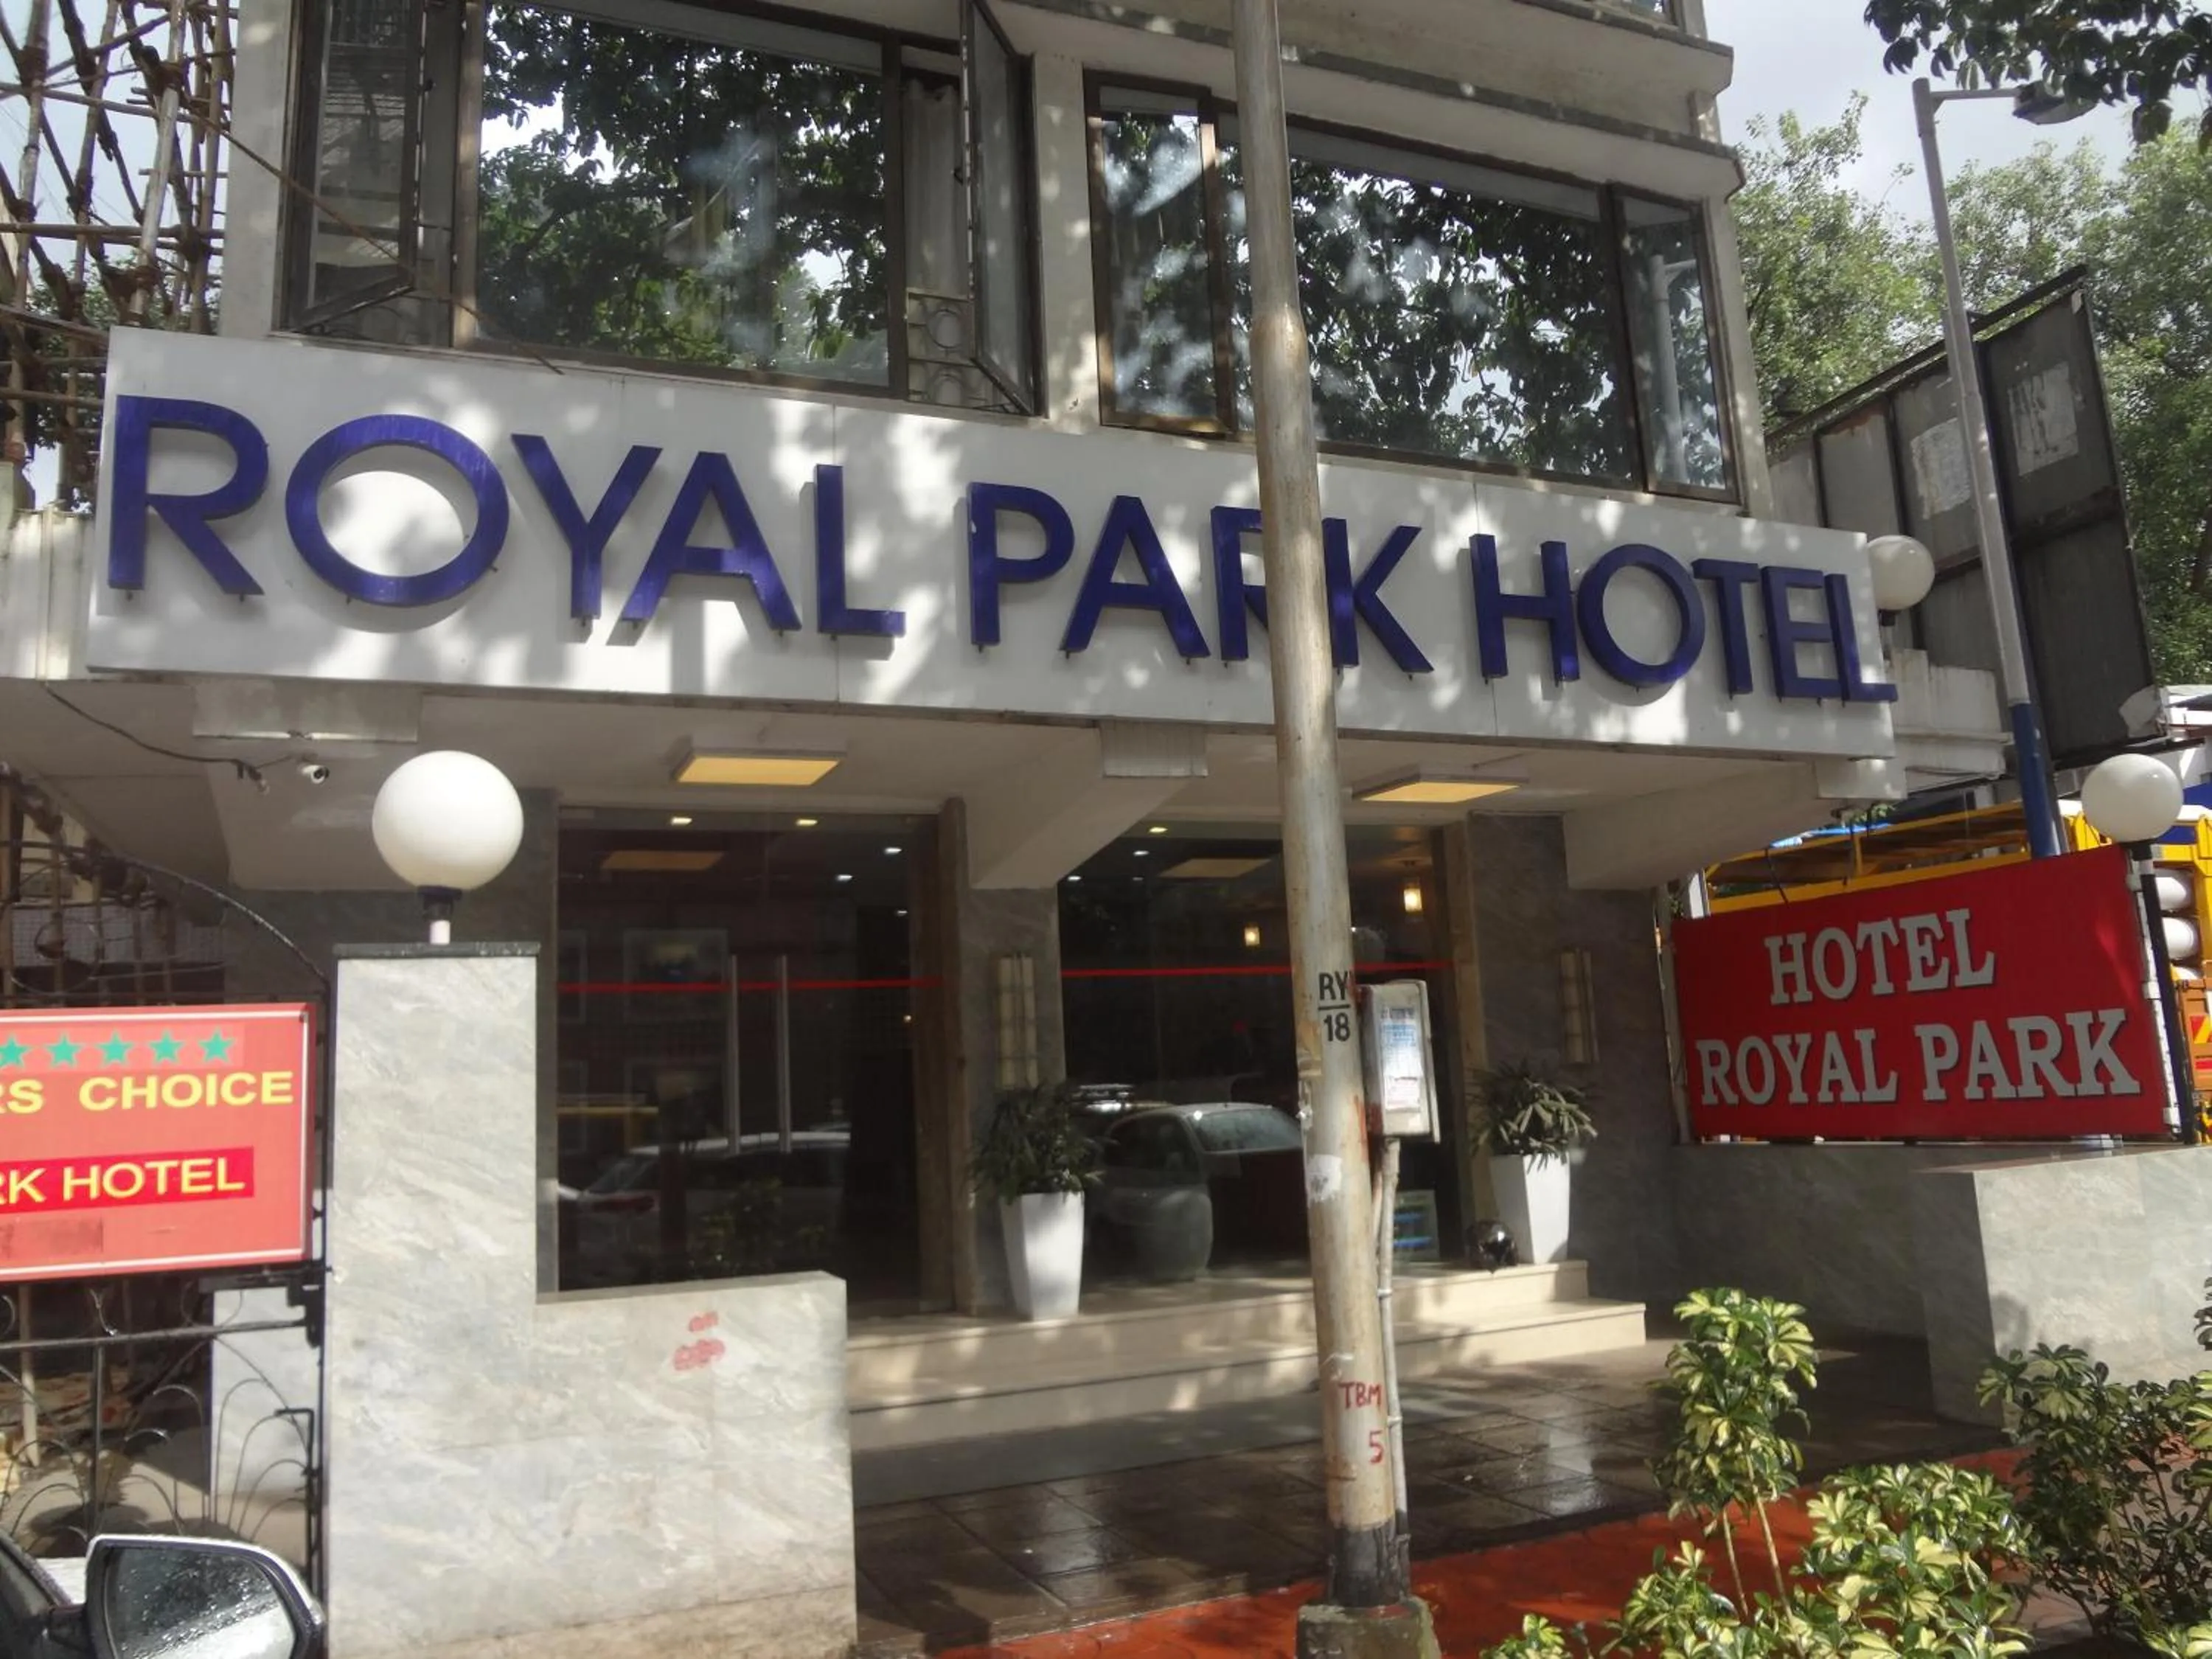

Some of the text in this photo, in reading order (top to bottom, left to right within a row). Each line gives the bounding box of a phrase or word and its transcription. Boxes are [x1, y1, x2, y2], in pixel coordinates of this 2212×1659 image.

[108, 394, 1899, 703] ROYAL PARK HOTEL
[1764, 908, 1994, 1006] HOTEL
[1323, 1012, 1350, 1042] 18
[1696, 1008, 2140, 1105] ROYAL PARK
[0, 1071, 294, 1114] S CHOICE
[0, 1156, 246, 1206] K HOTEL
[1368, 1430, 1384, 1464] 5
